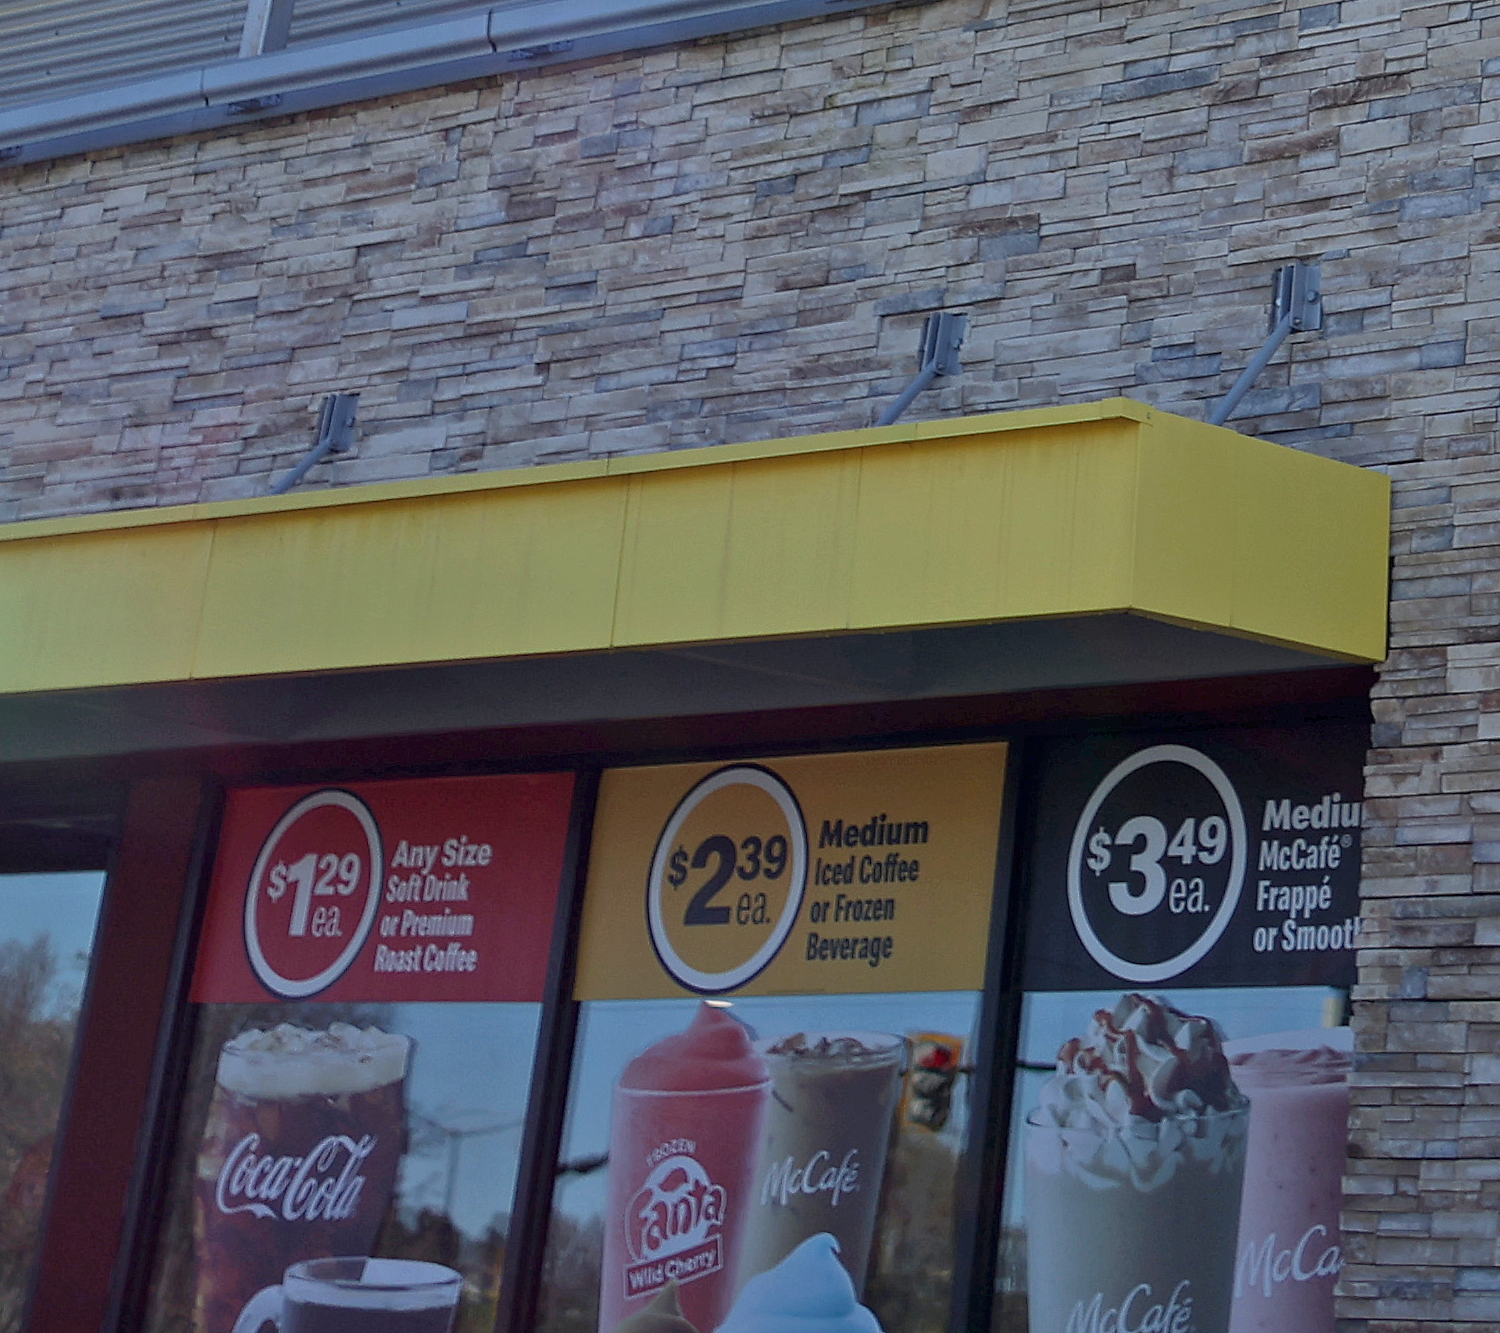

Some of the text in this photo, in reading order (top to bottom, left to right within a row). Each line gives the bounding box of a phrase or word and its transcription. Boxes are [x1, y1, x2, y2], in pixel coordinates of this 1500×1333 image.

[1261, 792, 1363, 832] Mediu
[818, 813, 929, 850] Medium
[391, 835, 493, 875] Any Size
[814, 852, 920, 886] Iced Coffee
[385, 872, 471, 904] Soft Drink
[1168, 876, 1211, 915] ea.
[1256, 875, 1333, 919] Frappé
[310, 904, 343, 938] ea.
[379, 907, 476, 939] or Premium
[736, 892, 771, 926] ea.
[809, 893, 896, 924] or Frozen
[806, 931, 894, 967] Beverage
[1252, 925, 1280, 952] or
[372, 941, 479, 973] Roast Coffee
[215, 1131, 379, 1222] Coca-Cola
[760, 1148, 860, 1207] McCafé
[629, 1248, 717, 1290] Wild Cherry
[1233, 1223, 1345, 1298] McCa
